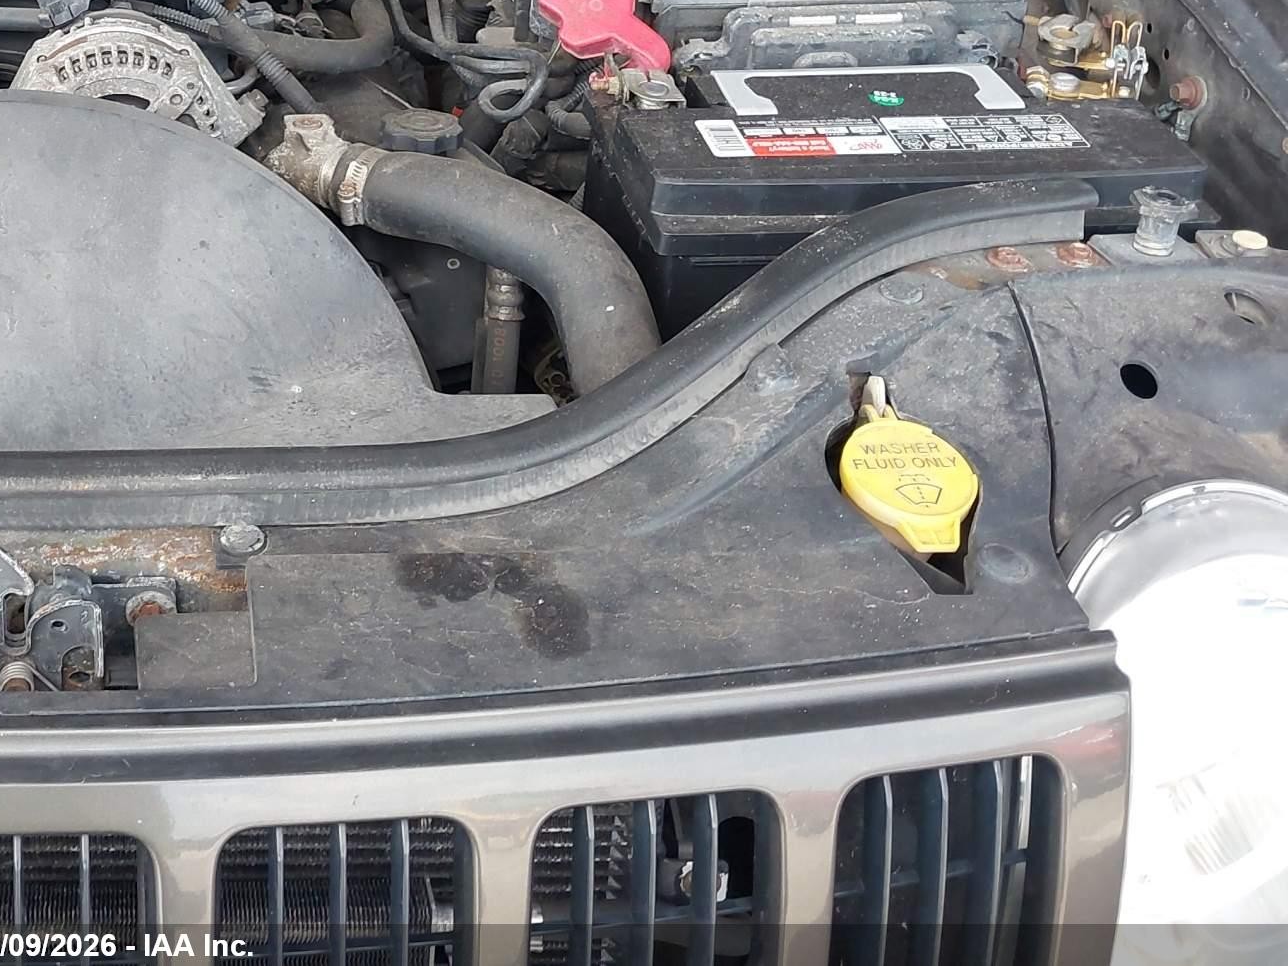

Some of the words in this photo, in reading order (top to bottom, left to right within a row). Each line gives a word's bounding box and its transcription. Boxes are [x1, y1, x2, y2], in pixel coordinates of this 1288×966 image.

[859, 441, 941, 455] WASHER
[852, 458, 907, 471] FLUID
[911, 457, 959, 470] ONLY
